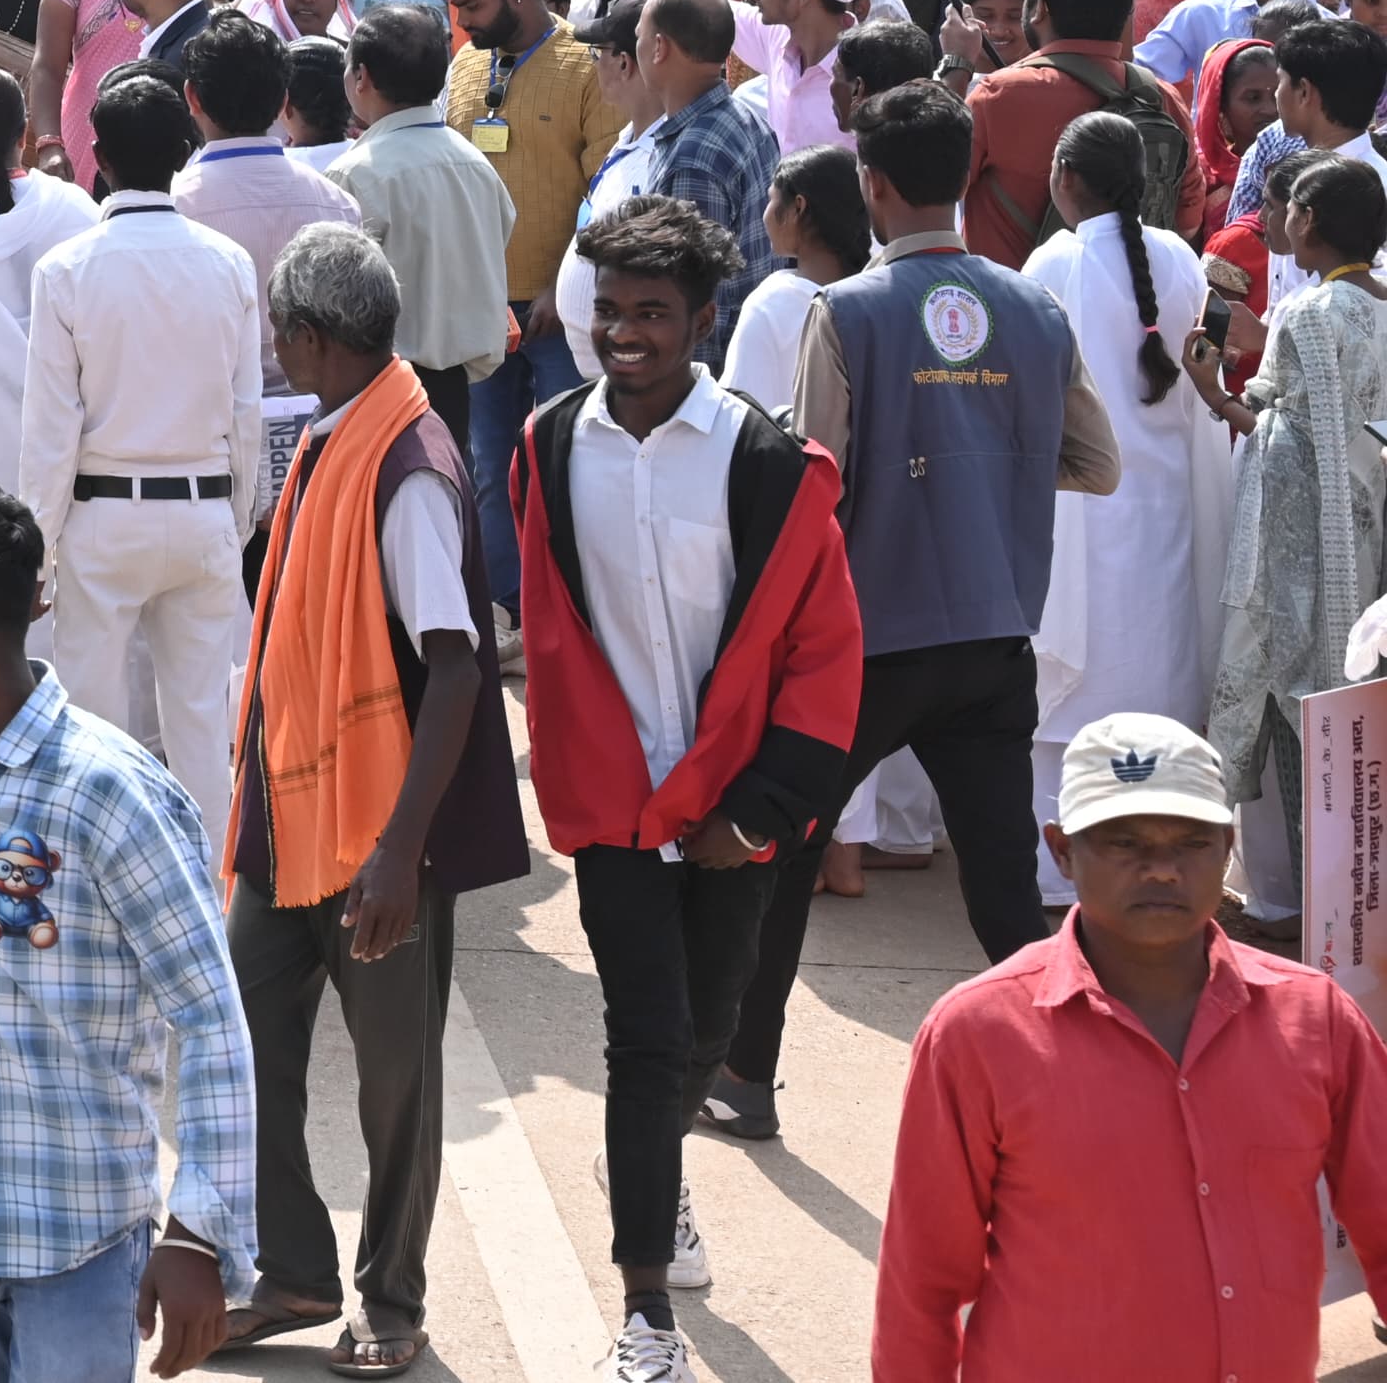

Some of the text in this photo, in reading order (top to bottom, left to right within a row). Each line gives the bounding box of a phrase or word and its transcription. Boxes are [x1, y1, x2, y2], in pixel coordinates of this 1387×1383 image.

[981, 369, 1009, 386] विभाग
[1350, 853, 1364, 896] नवीन
[1350, 899, 1363, 966] शासकीय
